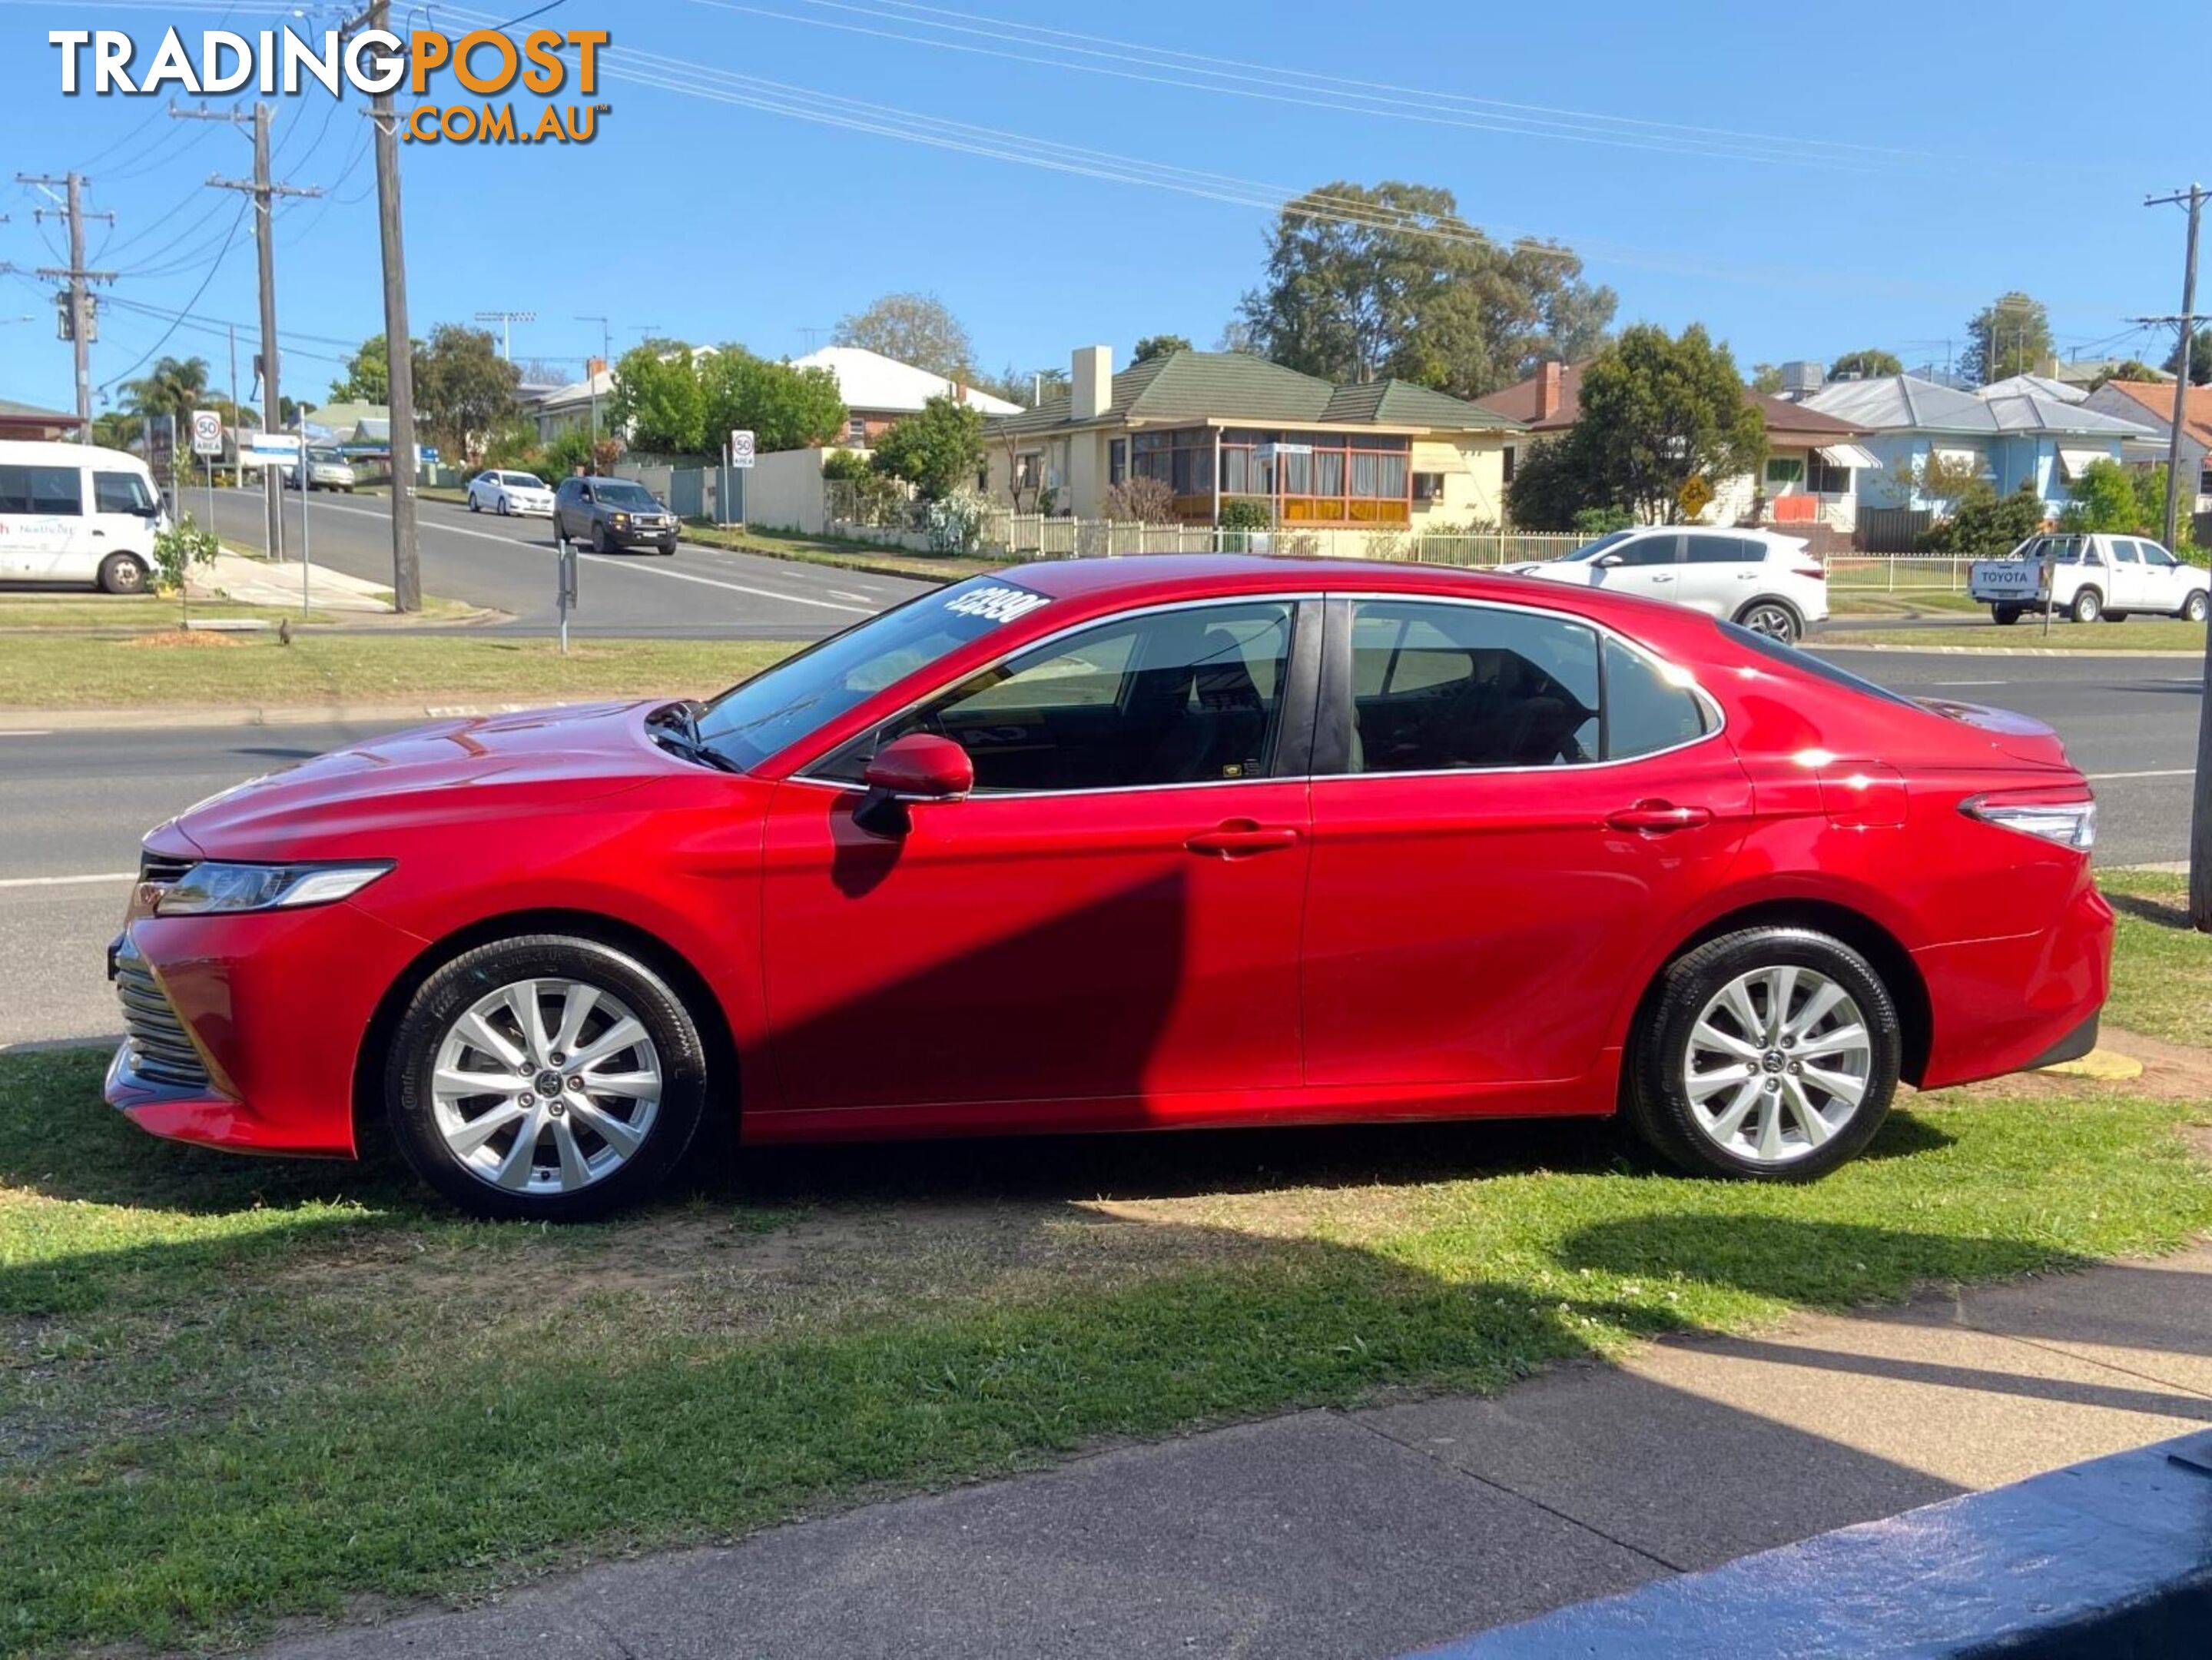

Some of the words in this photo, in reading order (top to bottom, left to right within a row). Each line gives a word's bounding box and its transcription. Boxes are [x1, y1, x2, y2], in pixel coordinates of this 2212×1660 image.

[199, 420, 216, 434] 50
[197, 440, 221, 450] AREA
[737, 439, 751, 450] 50
[1982, 573, 2028, 583] TOYOTA
